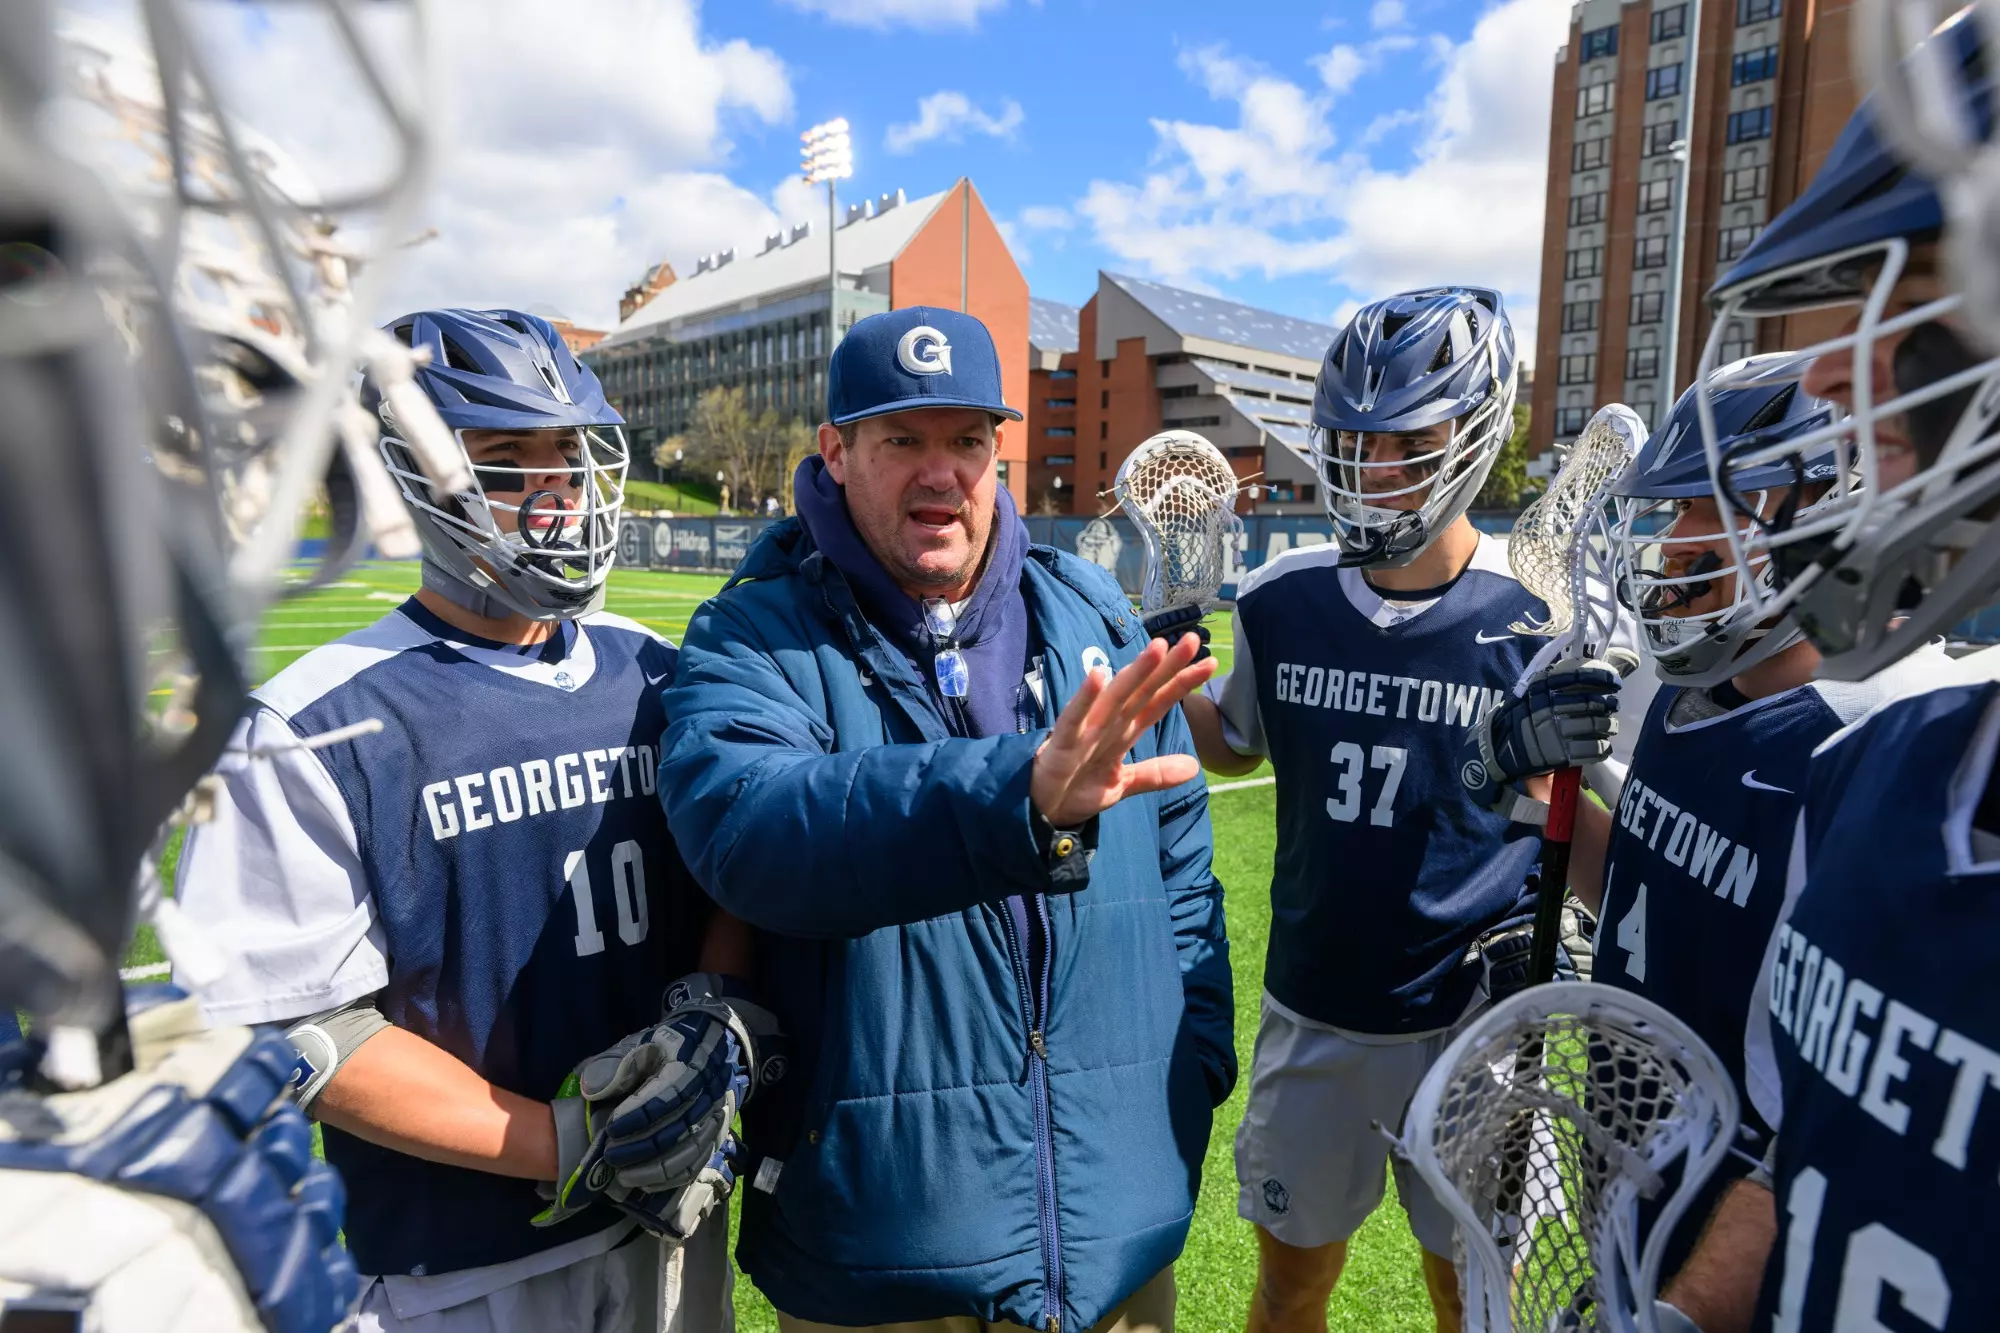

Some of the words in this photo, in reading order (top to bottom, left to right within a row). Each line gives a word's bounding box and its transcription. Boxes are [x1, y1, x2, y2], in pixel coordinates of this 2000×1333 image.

[897, 326, 952, 376] G
[1276, 662, 1504, 729] GEORGETOWN
[421, 745, 662, 842] GEORGETO
[1326, 740, 1408, 828] 37
[1620, 774, 1758, 908] GETOWN
[563, 839, 649, 957] 10
[1769, 922, 2000, 1172] GEORGET
